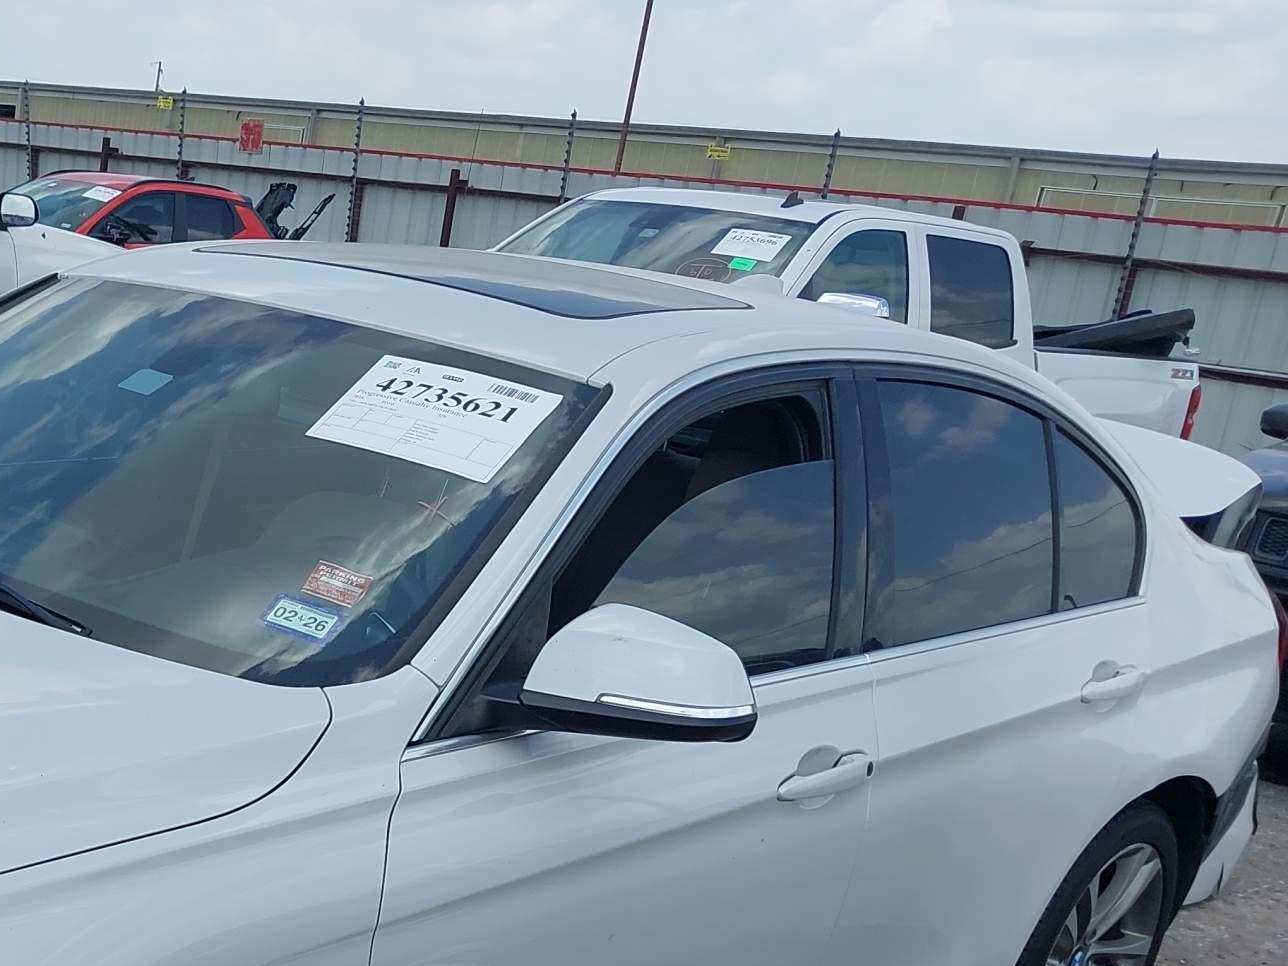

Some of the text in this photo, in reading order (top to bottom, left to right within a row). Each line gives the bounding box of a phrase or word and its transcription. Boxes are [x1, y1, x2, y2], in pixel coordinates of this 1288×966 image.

[356, 388, 399, 401] Progressive
[375, 377, 520, 423] 42735621
[319, 565, 365, 584] PARKING
